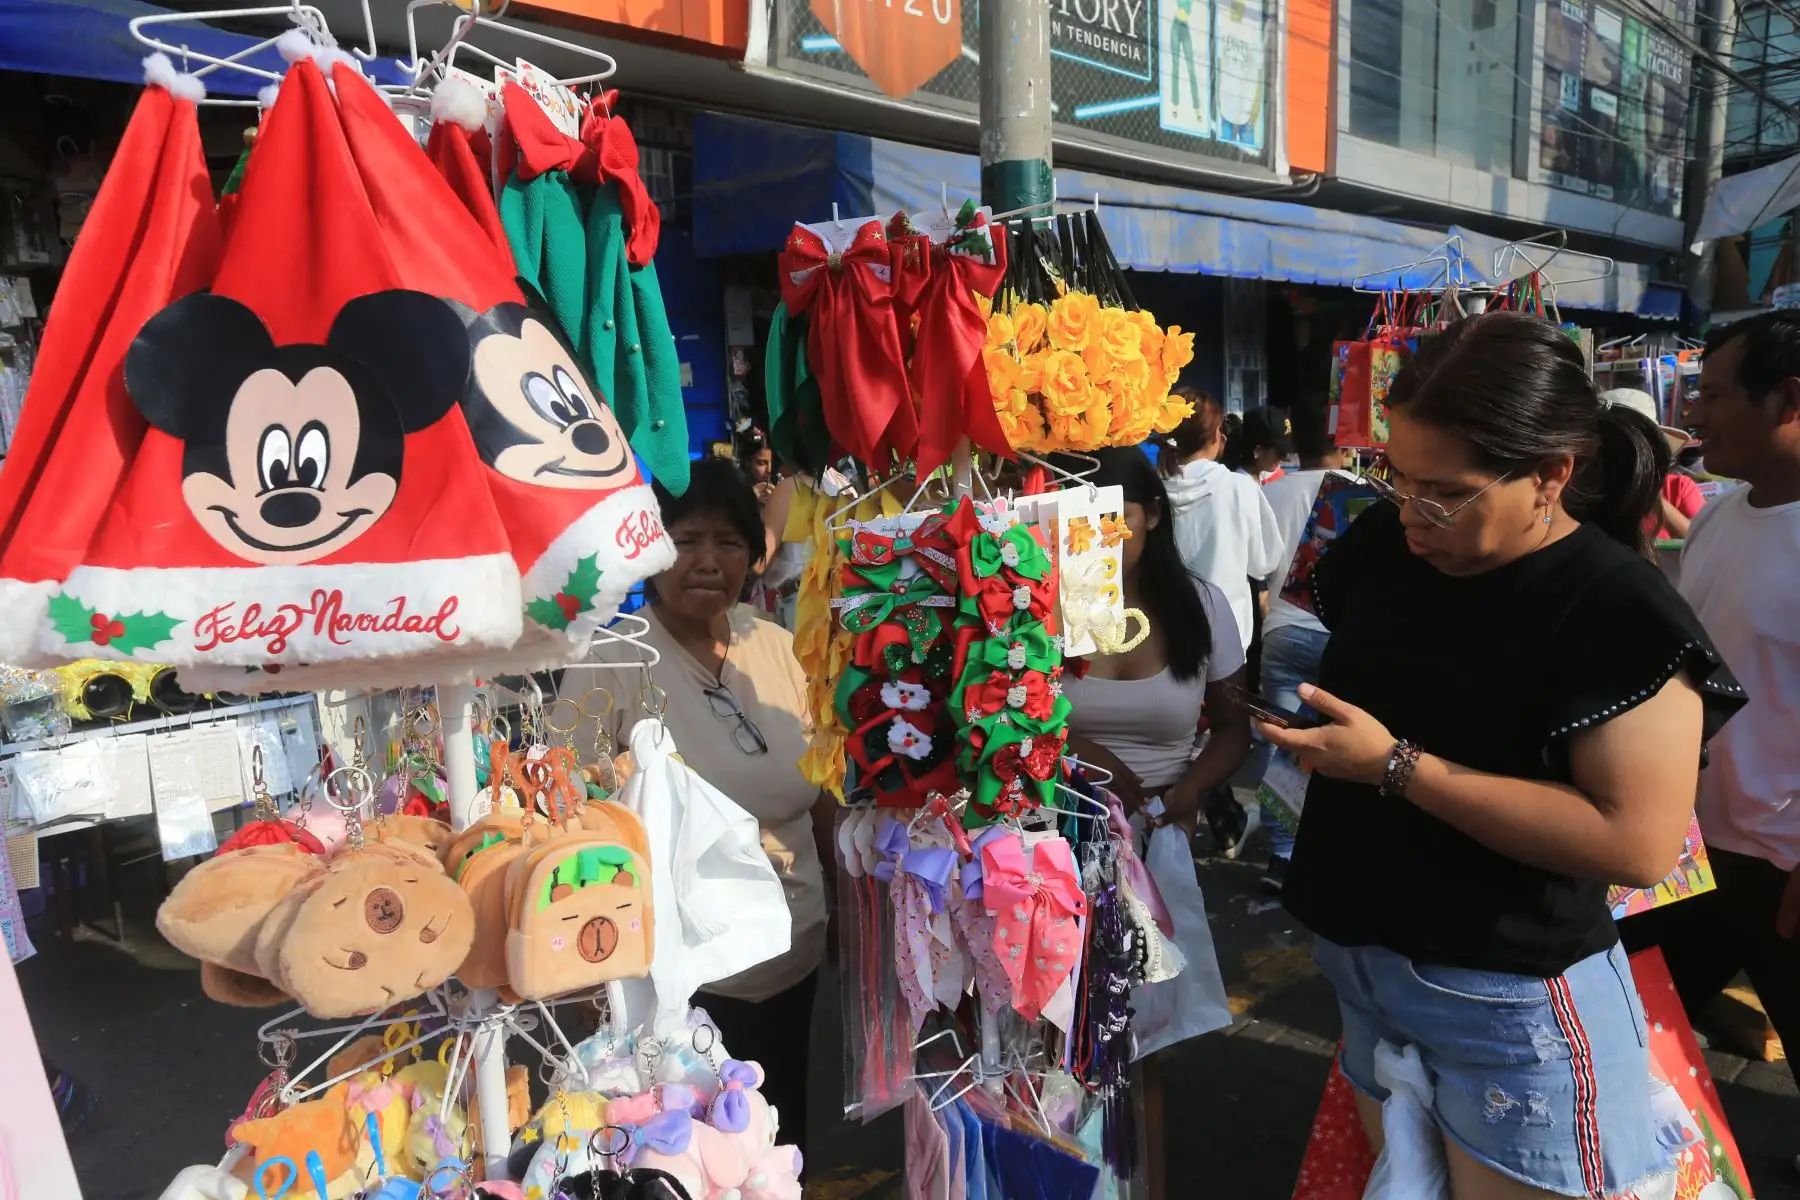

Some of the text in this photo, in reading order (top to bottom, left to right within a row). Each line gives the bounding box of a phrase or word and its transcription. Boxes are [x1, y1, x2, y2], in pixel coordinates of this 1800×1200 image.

[1066, 25, 1141, 61] TENDENCIA
[194, 589, 460, 654] Feliz Navidad
